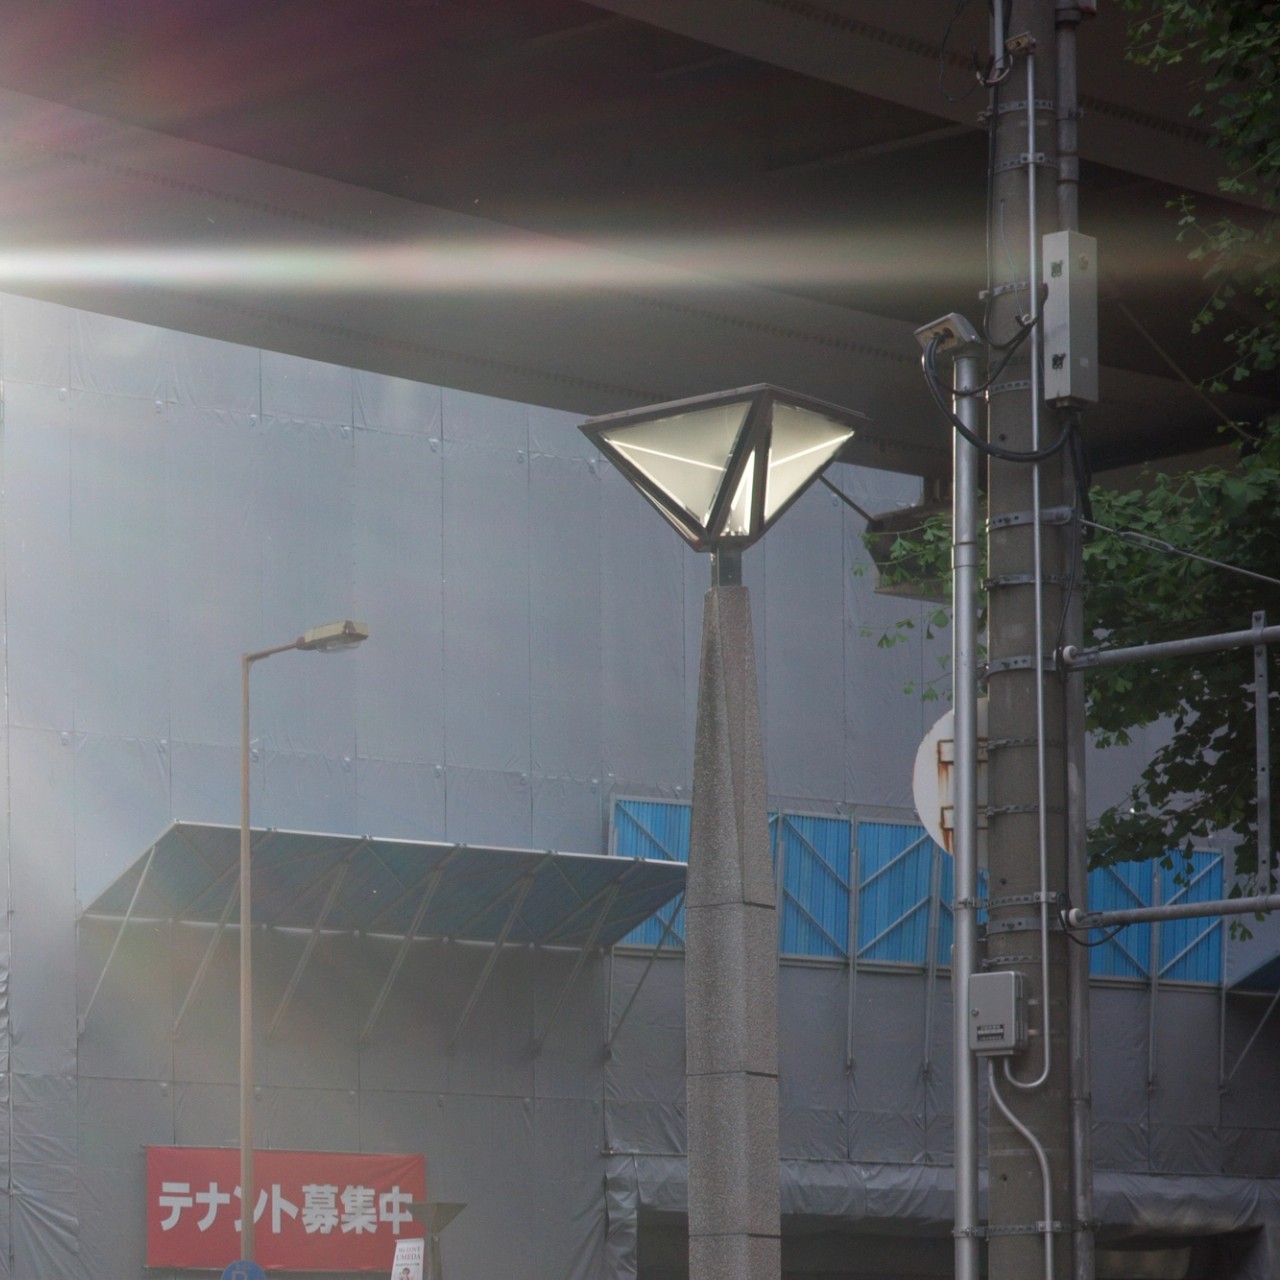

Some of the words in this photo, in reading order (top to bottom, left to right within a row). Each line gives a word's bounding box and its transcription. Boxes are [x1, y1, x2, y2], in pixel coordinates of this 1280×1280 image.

[158, 1181, 414, 1235] テナント募集中
